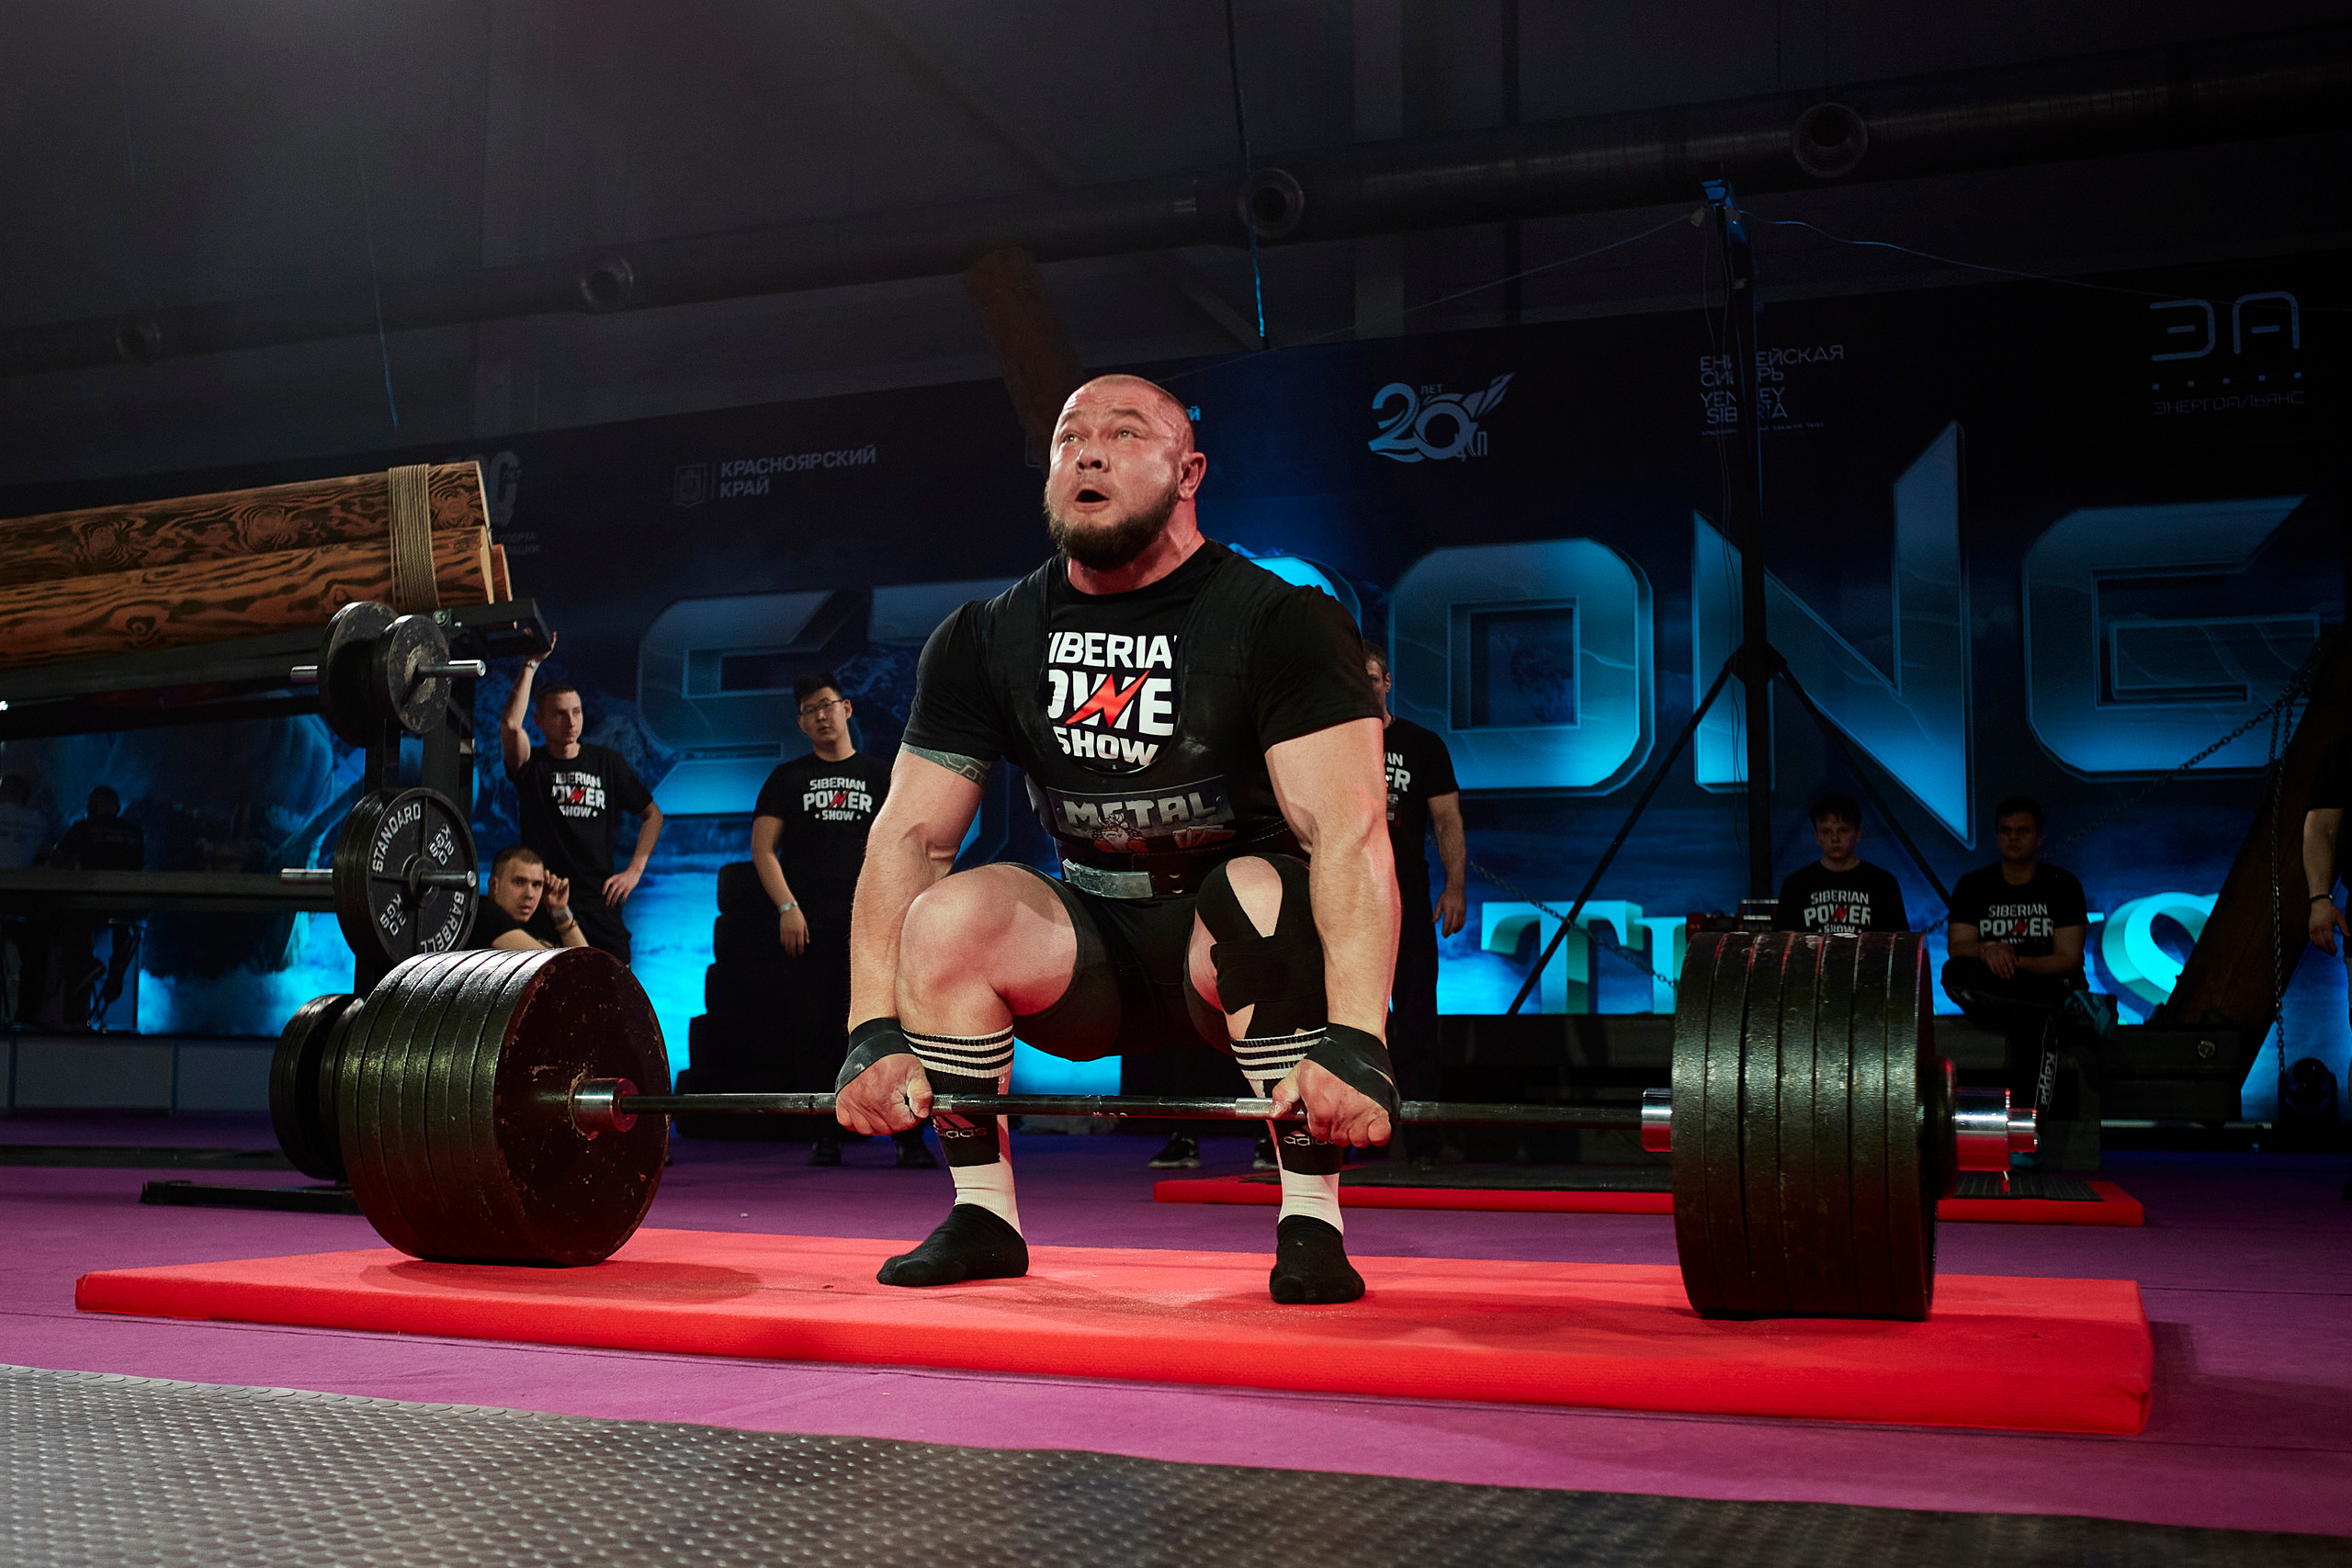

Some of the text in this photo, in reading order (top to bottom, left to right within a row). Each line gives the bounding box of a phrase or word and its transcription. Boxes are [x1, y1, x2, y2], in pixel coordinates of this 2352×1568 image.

[1700, 386, 1785, 408] YENEY
[2153, 390, 2305, 415] ЭНЕРГОАЛЬЯНС
[1706, 402, 1789, 424] SIBRIA
[720, 445, 876, 478] КРАСНОЯРСКИЙ
[720, 475, 770, 498] КРАЙ
[809, 776, 866, 792] SIBERIAN
[802, 789, 874, 814] POWER
[1063, 792, 1216, 829] METAL
[821, 809, 855, 821] SHOW
[372, 802, 423, 874] STANDARD
[427, 823, 452, 858] KGS
[436, 841, 455, 866] 20
[1810, 888, 1870, 906] SIBERIAN
[379, 892, 403, 930] KGS
[419, 890, 465, 954] BARBELL
[1804, 903, 1871, 928] POWER
[1988, 902, 2049, 919] SIBERIAN
[2040, 1051, 2056, 1105] Kappa
